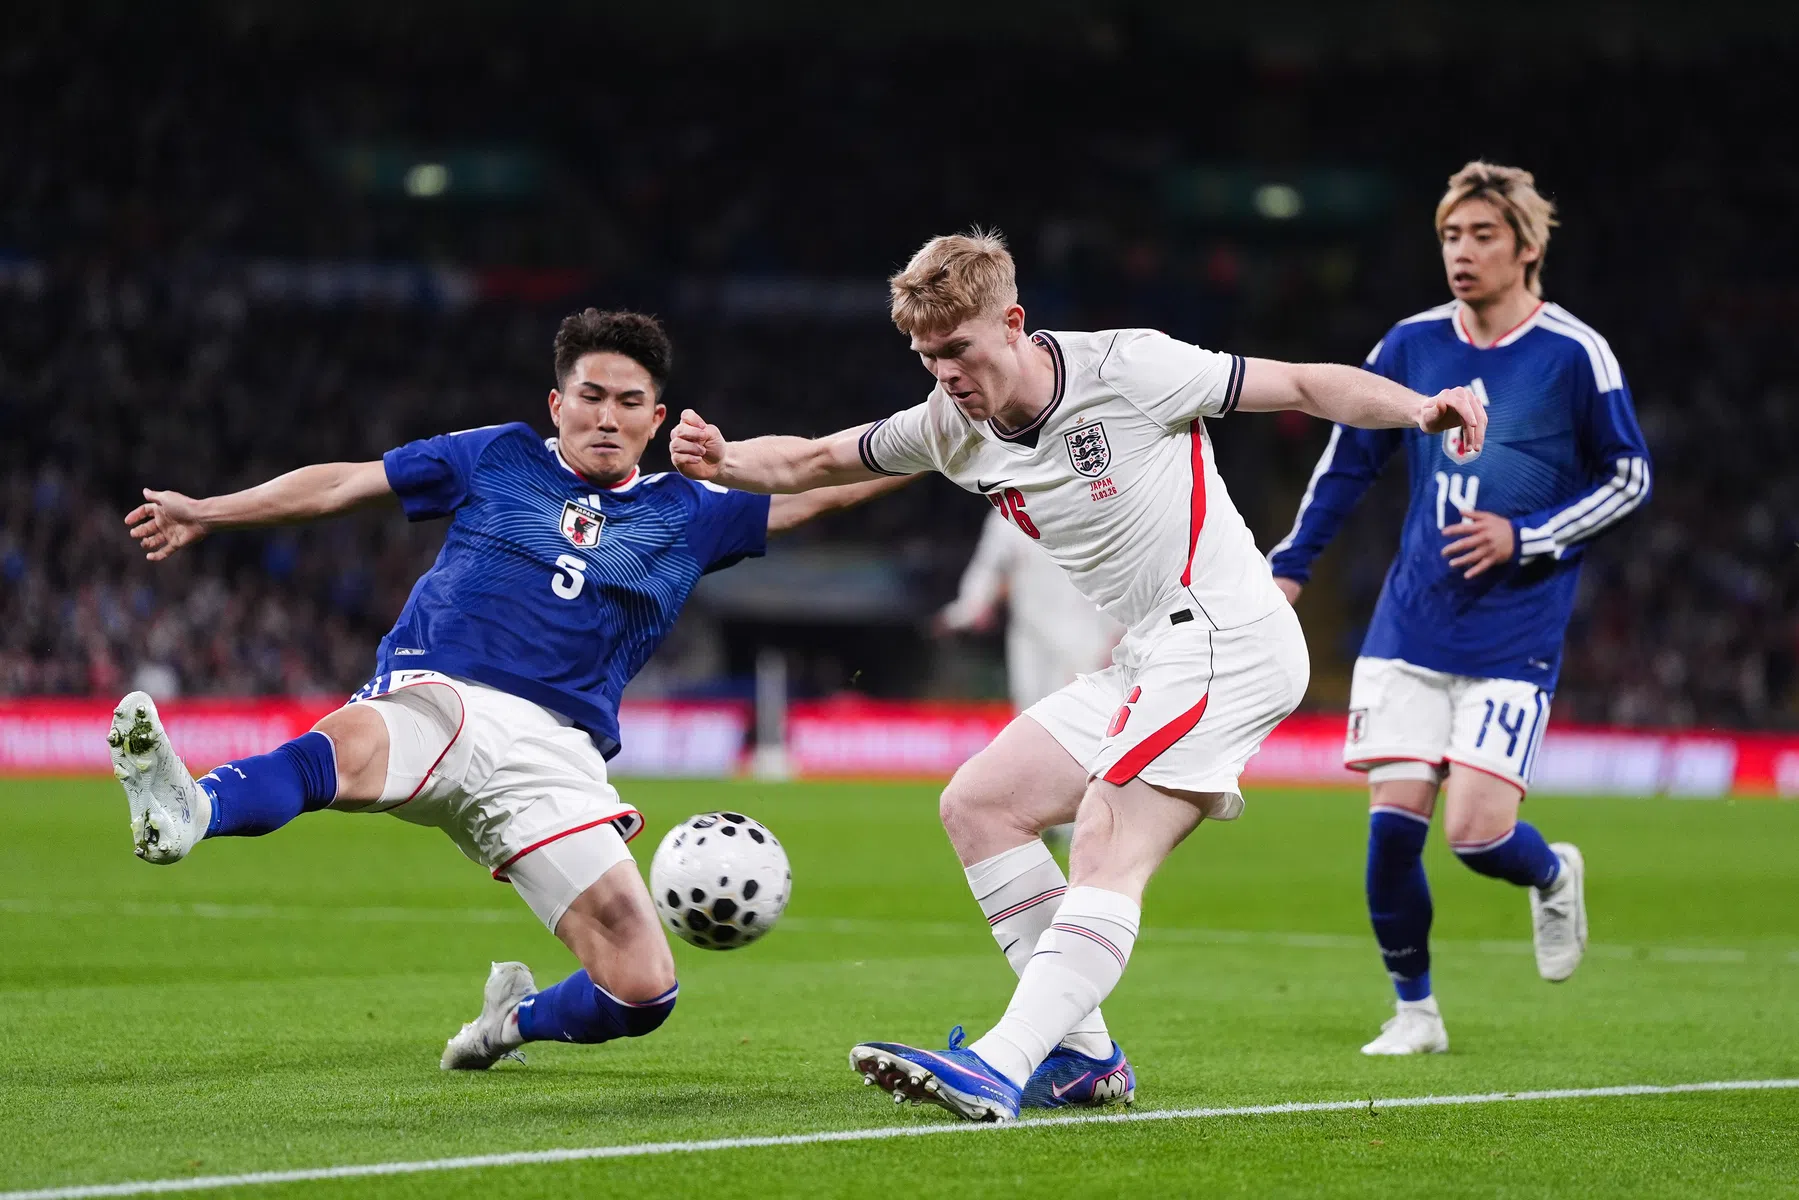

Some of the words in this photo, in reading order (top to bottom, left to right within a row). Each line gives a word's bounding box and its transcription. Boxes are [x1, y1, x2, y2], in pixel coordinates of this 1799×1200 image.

[1089, 477, 1113, 492] JAPAN
[1090, 486, 1118, 502] 31.03.26
[574, 506, 596, 519] JAPAN
[1435, 471, 1480, 530] 14
[551, 554, 587, 600] 5
[1475, 698, 1526, 758] 14
